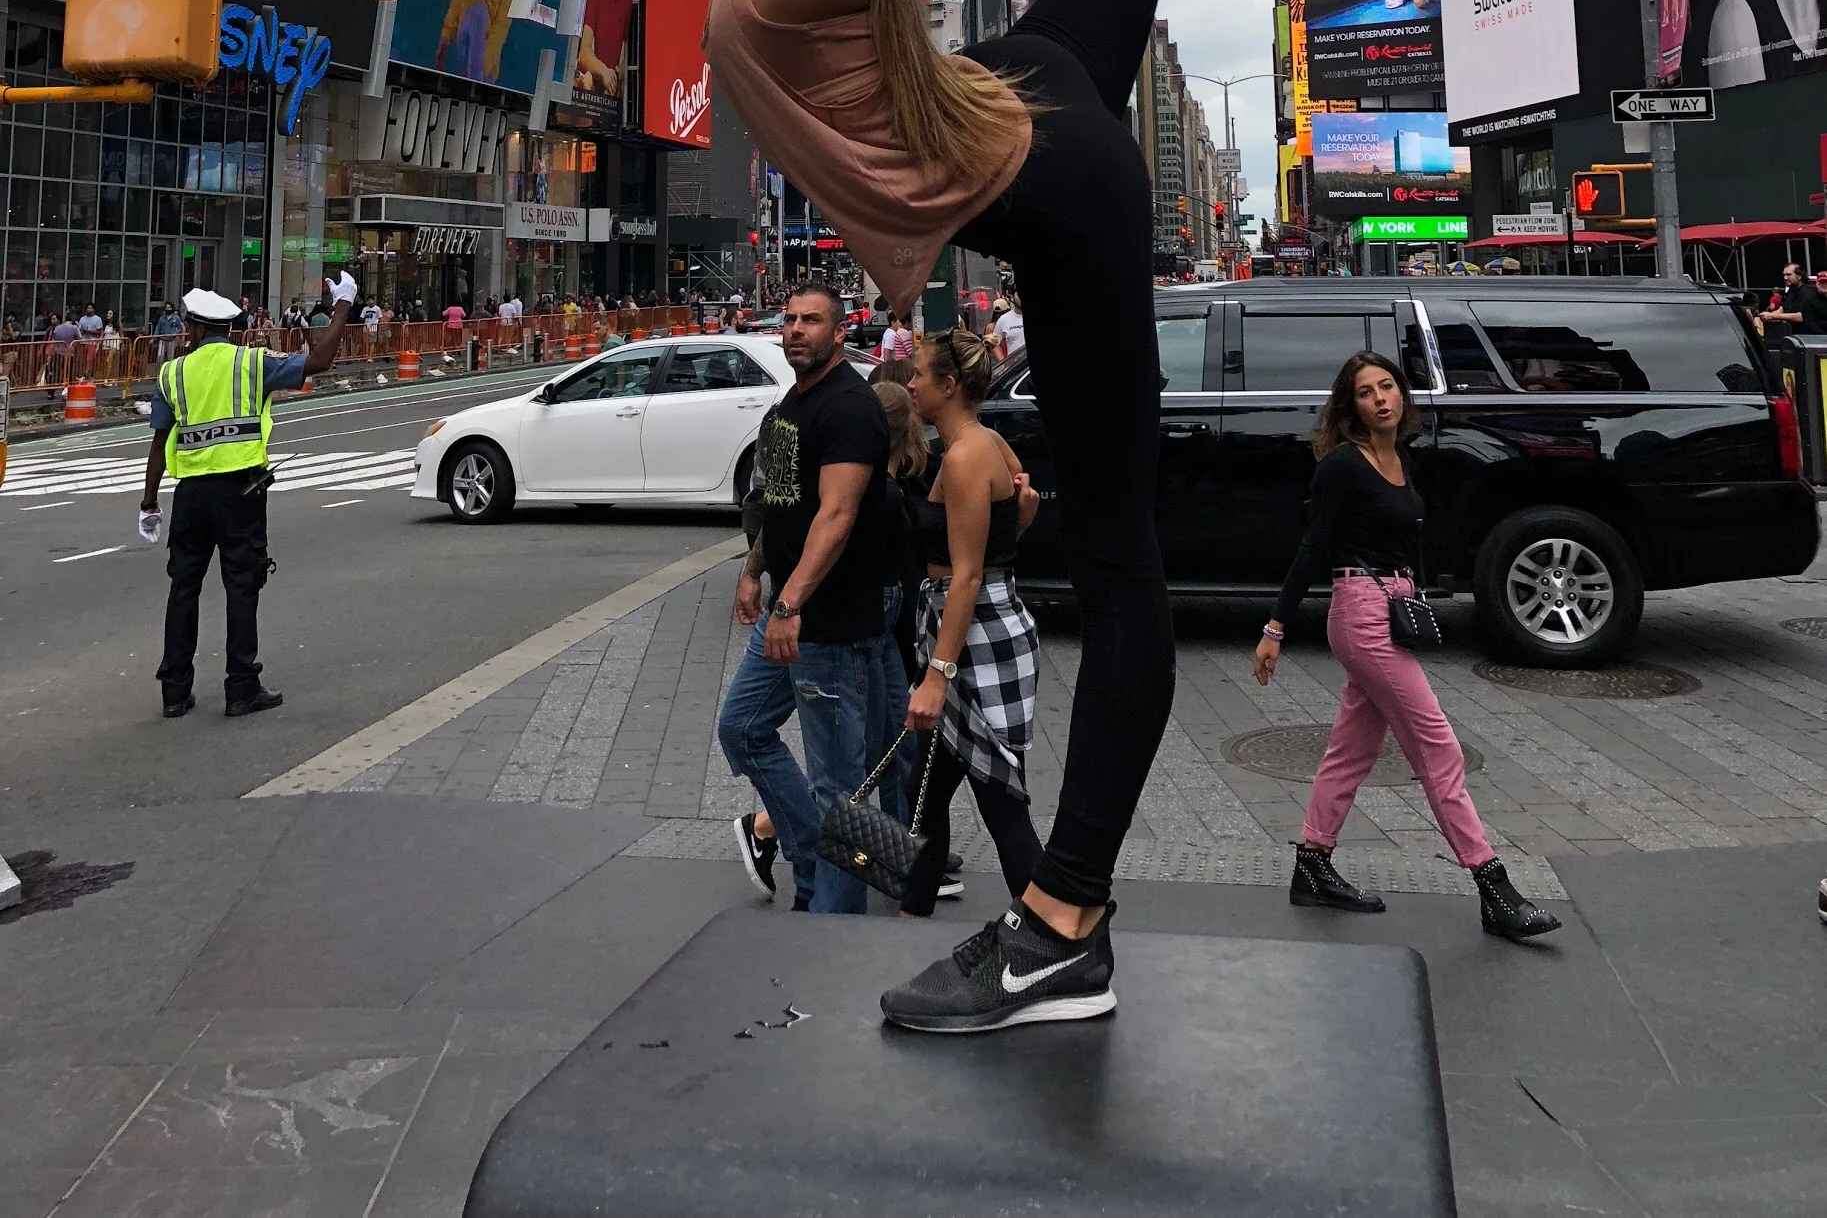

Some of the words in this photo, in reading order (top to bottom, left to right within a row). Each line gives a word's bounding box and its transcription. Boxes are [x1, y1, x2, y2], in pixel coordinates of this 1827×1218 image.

[1475, 13, 1503, 31] SWISS
[1507, 1, 1533, 19] MADE
[1314, 33, 1336, 43] MAKE
[1336, 31, 1356, 41] YOUR
[1357, 27, 1404, 39] RESERVATION
[1314, 51, 1359, 60] RWCatskills.com
[581, 92, 618, 107] AUTHENTICALLY
[669, 62, 711, 137] Persol
[1628, 100, 1657, 113] ONE
[1669, 98, 1699, 111] WAY
[381, 85, 508, 175] FOREVER
[1462, 125, 1472, 137] THE
[1472, 122, 1489, 135] WORLD
[1489, 121, 1494, 132] IS
[1494, 116, 1519, 131] WATCHING
[1520, 109, 1557, 125] #SWATCHTHIS
[1327, 133, 1354, 142] MAKE
[1354, 133, 1379, 142] YOUR
[1321, 143, 1380, 152] RESERVATION
[1328, 190, 1383, 198] RWCatskills.com
[521, 207, 535, 224] U.S.
[536, 208, 557, 225] POLO
[559, 210, 580, 227] ASSN.
[1496, 217, 1527, 225] PEDESTRIAN
[535, 228, 552, 237] SINCE
[553, 229, 567, 237] 1890
[620, 217, 646, 240] sunglass
[646, 218, 657, 237] hut
[1378, 221, 1416, 233] YORK
[1437, 221, 1468, 233] LINE
[1524, 225, 1536, 233] KEEP
[1538, 225, 1558, 233] MOVING
[413, 226, 467, 254] FOREVER
[465, 230, 481, 254] 21
[183, 425, 240, 444] NYPD
